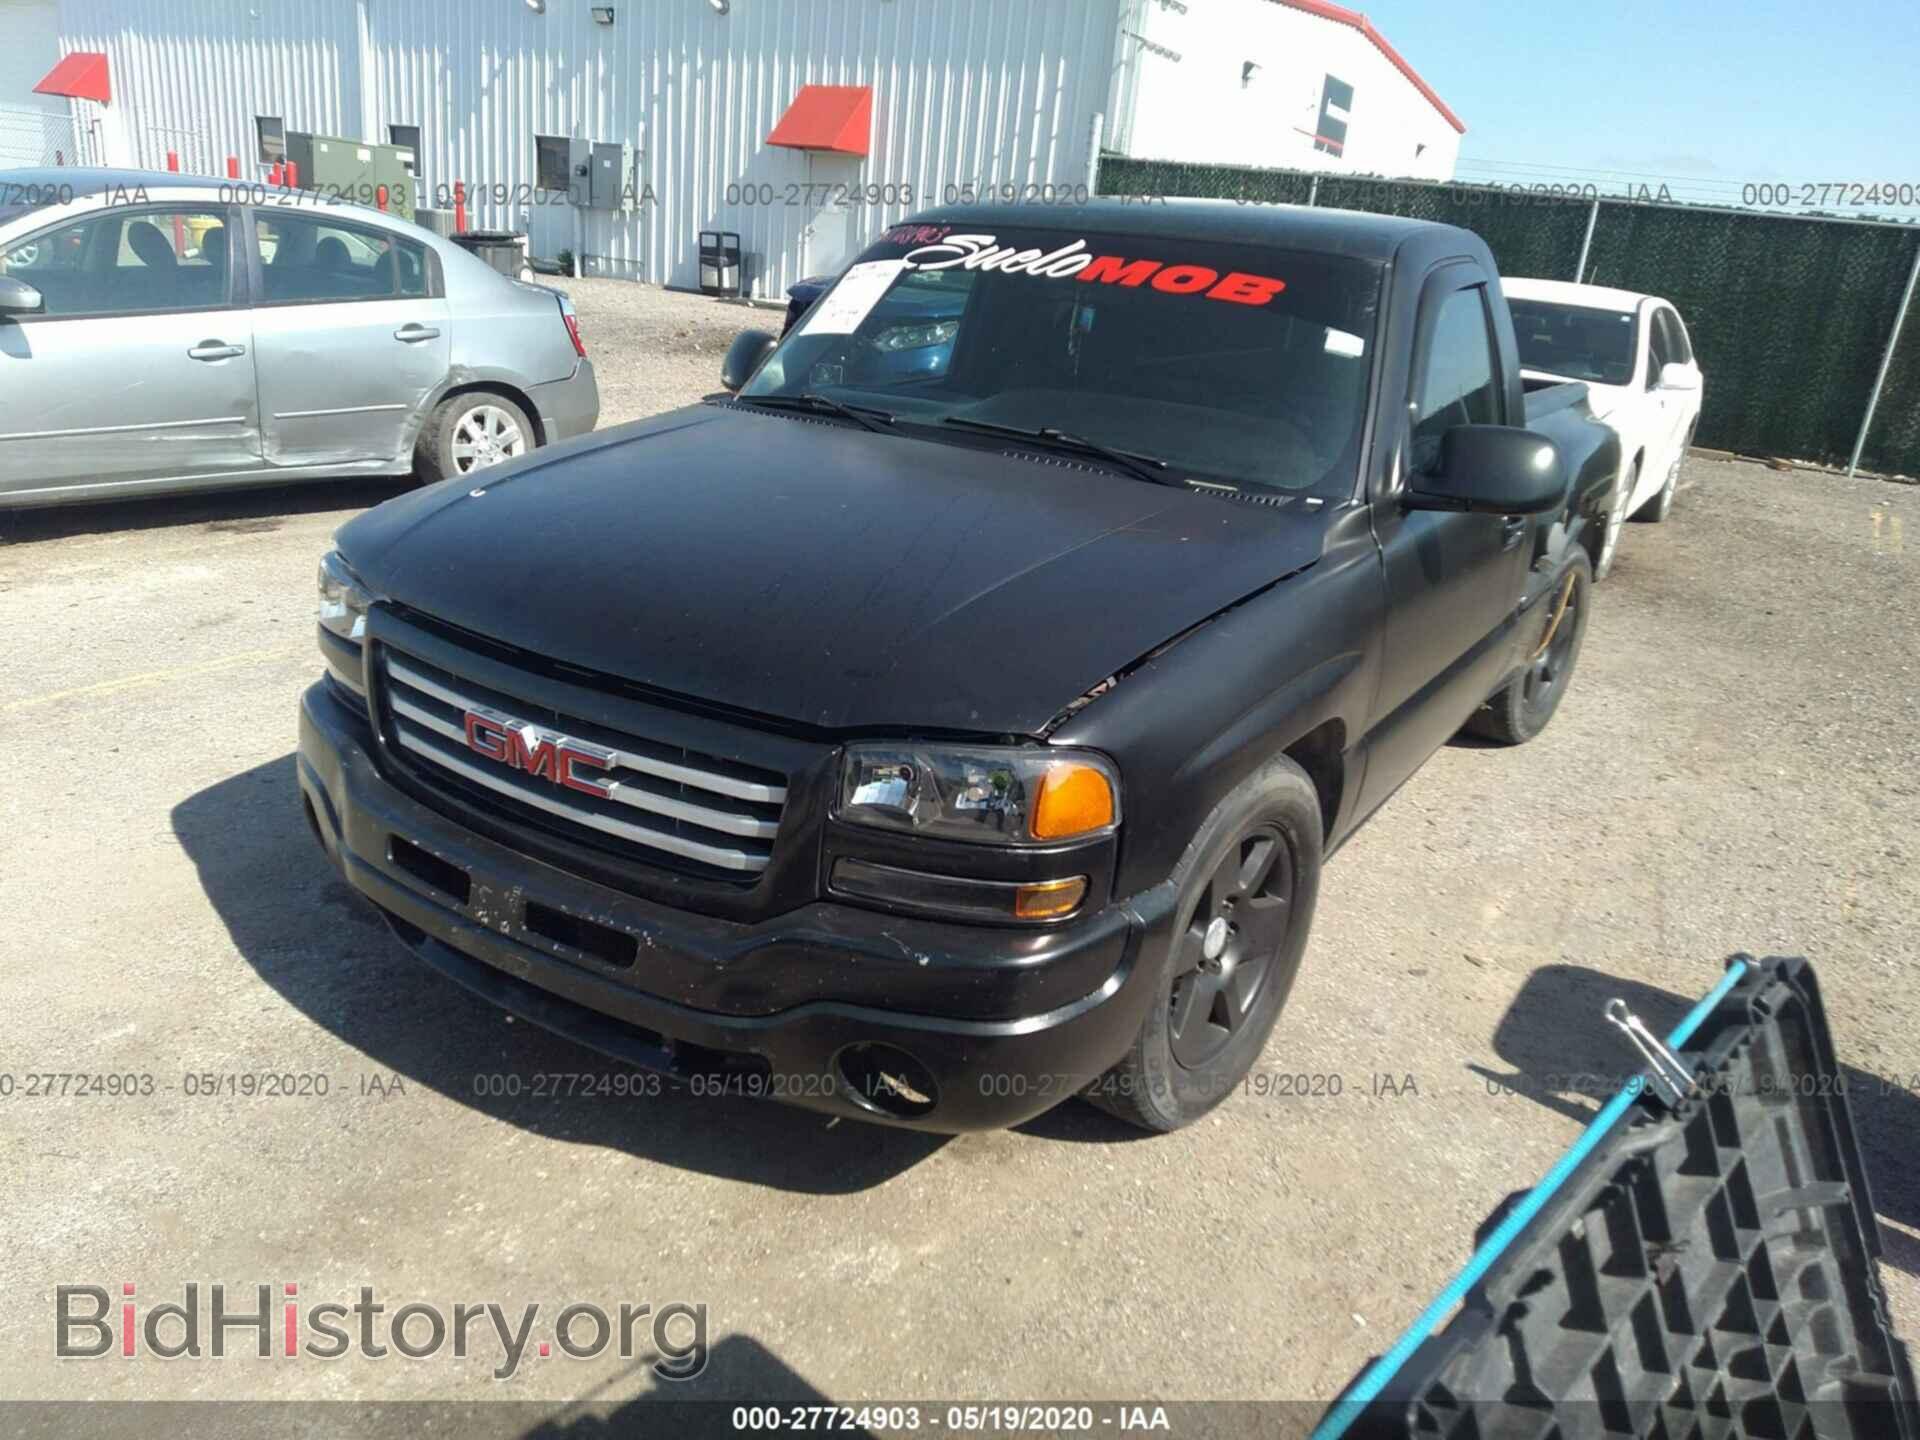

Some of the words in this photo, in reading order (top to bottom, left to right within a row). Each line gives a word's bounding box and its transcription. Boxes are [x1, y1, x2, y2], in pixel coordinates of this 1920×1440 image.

[901, 234, 1097, 278] Suelo
[1075, 255, 1287, 306] MOB
[463, 706, 618, 800] GMC
